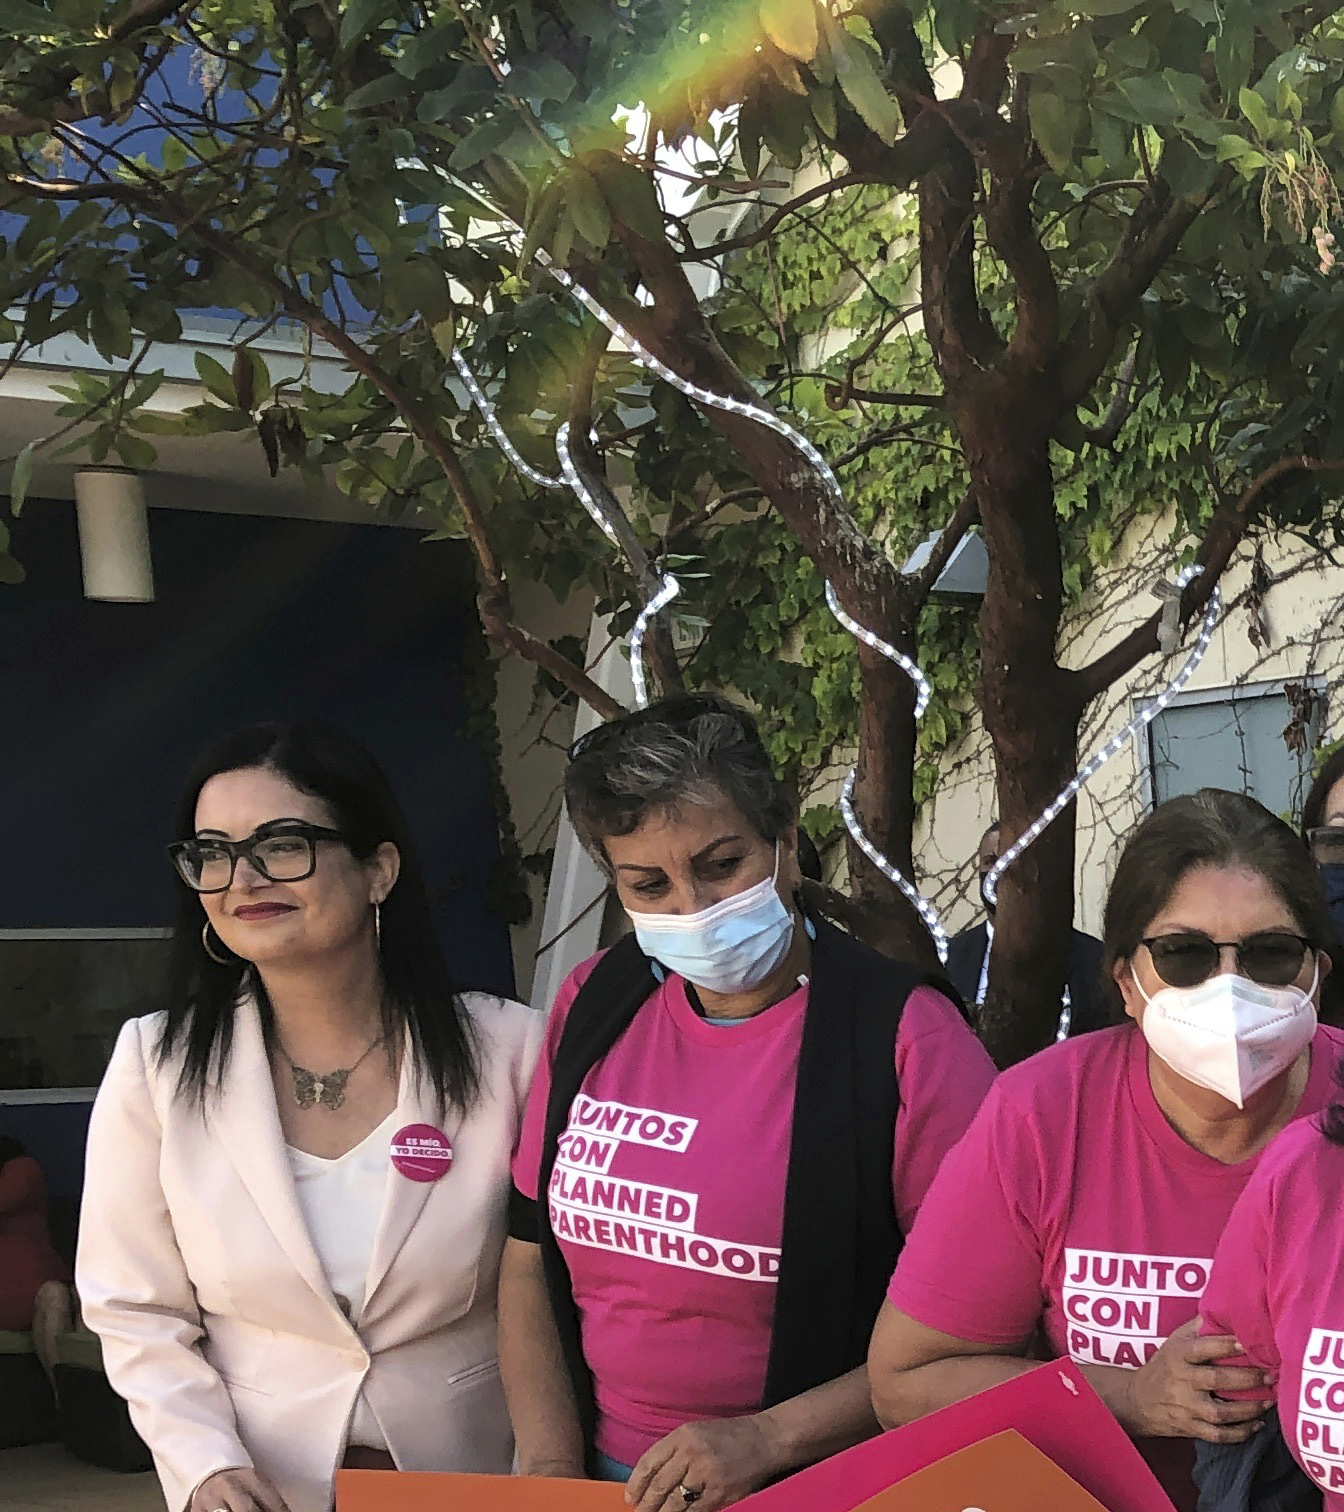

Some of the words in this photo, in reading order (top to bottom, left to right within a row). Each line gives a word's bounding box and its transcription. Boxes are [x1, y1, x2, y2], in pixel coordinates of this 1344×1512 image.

[572, 1100, 689, 1146] UNTOS
[412, 1148, 449, 1158] DECIDO
[551, 1168, 691, 1223] PLANNED
[550, 1205, 780, 1277] PARENTHOOD
[1070, 1255, 1207, 1292] JUNTO
[1067, 1294, 1152, 1330] CON
